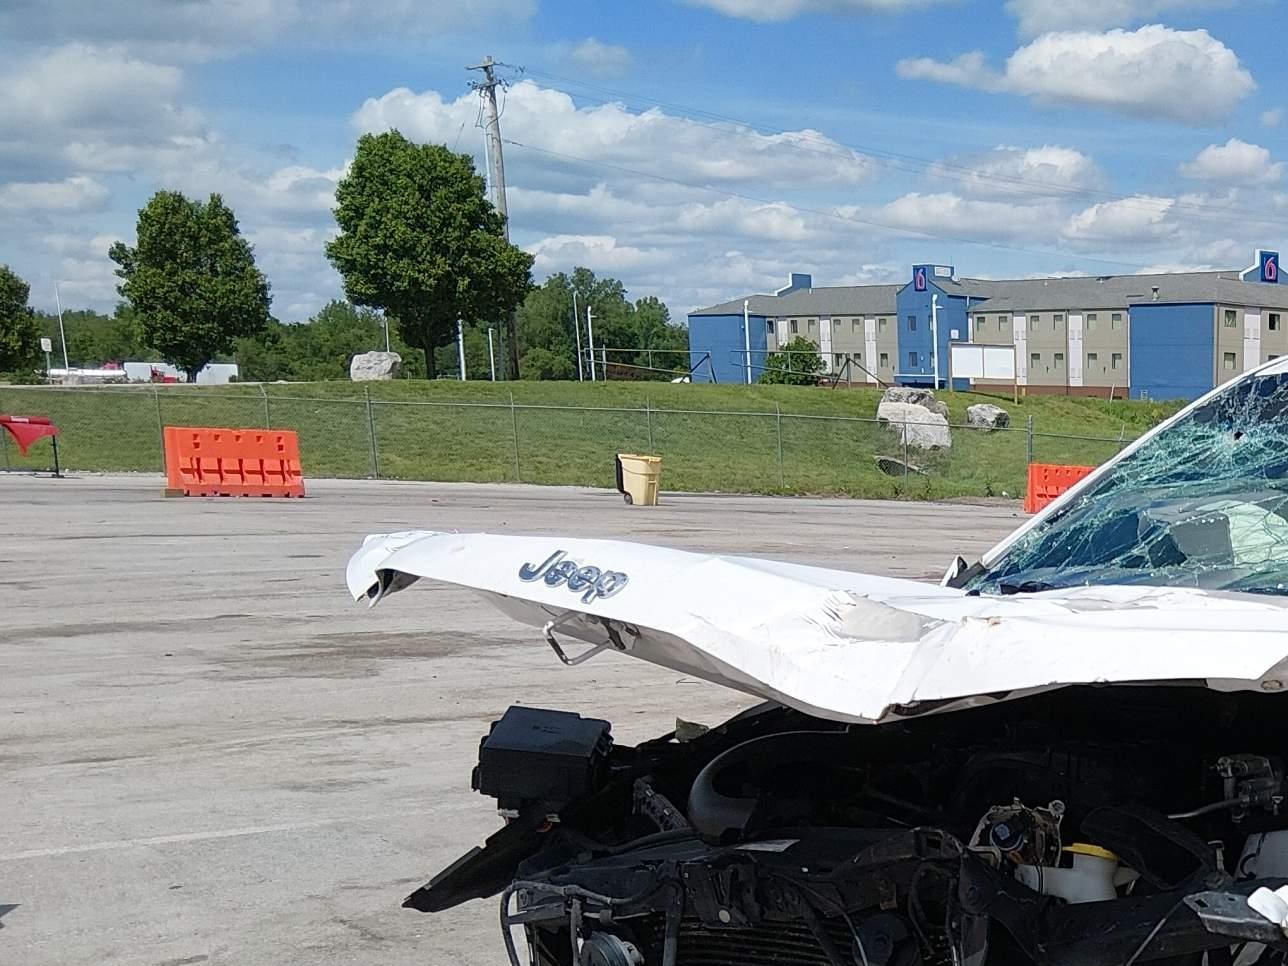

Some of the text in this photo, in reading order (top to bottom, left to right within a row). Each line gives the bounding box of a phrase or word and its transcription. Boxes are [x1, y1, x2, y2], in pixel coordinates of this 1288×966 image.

[915, 268, 926, 291] 6
[1264, 256, 1277, 281] 6
[518, 549, 630, 605] Jeep
